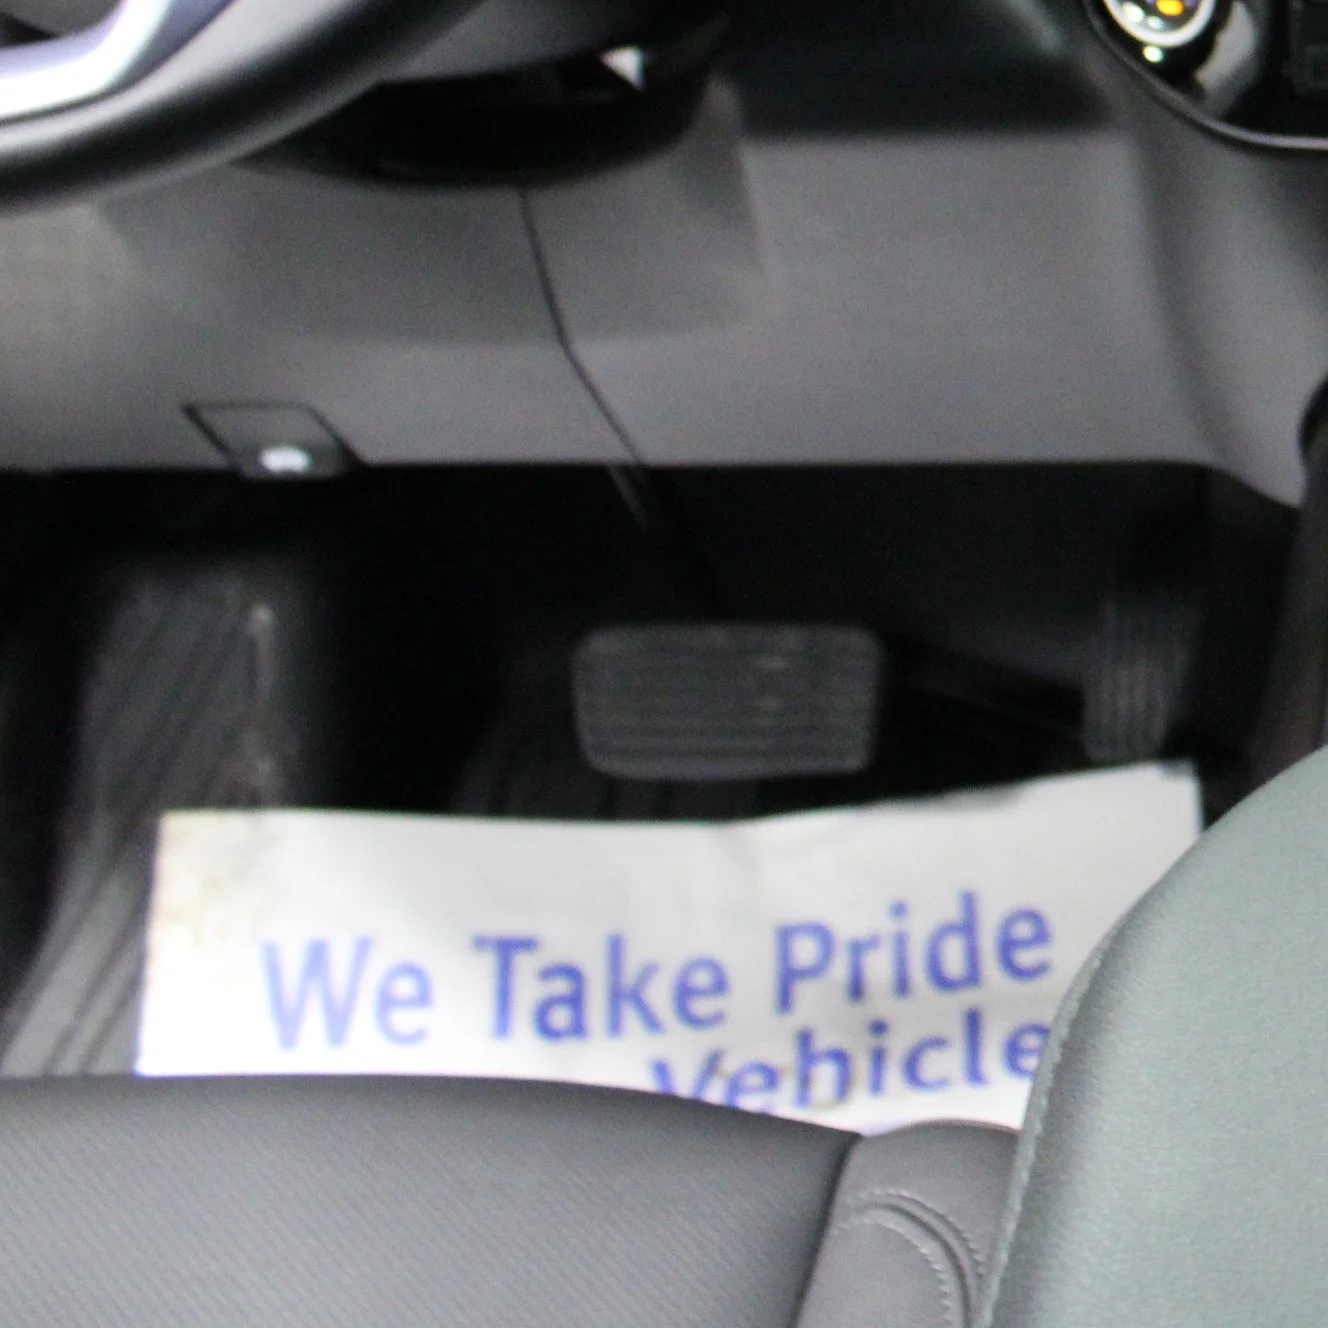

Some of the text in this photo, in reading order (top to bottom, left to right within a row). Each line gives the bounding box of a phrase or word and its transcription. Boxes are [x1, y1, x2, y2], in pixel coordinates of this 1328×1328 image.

[262, 890, 1053, 1050] We Take Pride
